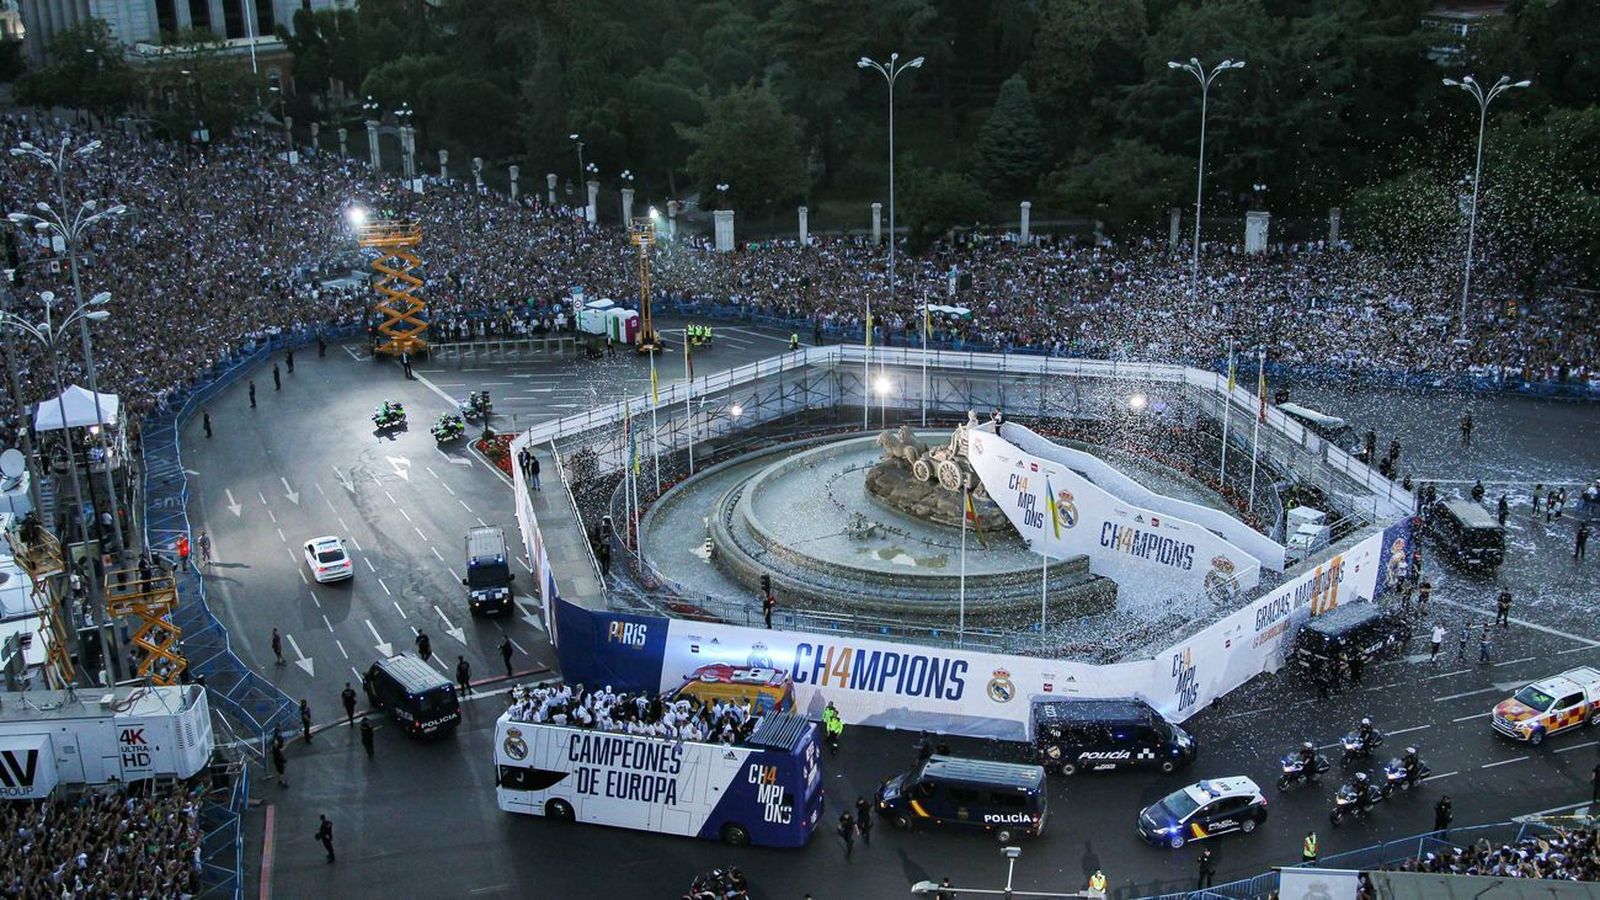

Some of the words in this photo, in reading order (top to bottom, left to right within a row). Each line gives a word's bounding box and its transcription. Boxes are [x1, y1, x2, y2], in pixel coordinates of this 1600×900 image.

[1018, 491, 1036, 510] MPI
[1024, 509, 1044, 528] ONS
[792, 642, 968, 701] CH4MPIONS
[120, 729, 147, 745] 4K
[122, 753, 151, 767] HD
[568, 734, 683, 775] CAMPEONES
[1078, 749, 1131, 760] POLICÍA
[577, 768, 599, 794] DE
[605, 772, 677, 806] EUROPA
[757, 784, 784, 805] MPI
[764, 803, 792, 824] ONS
[984, 812, 1032, 823] POLICÍA
